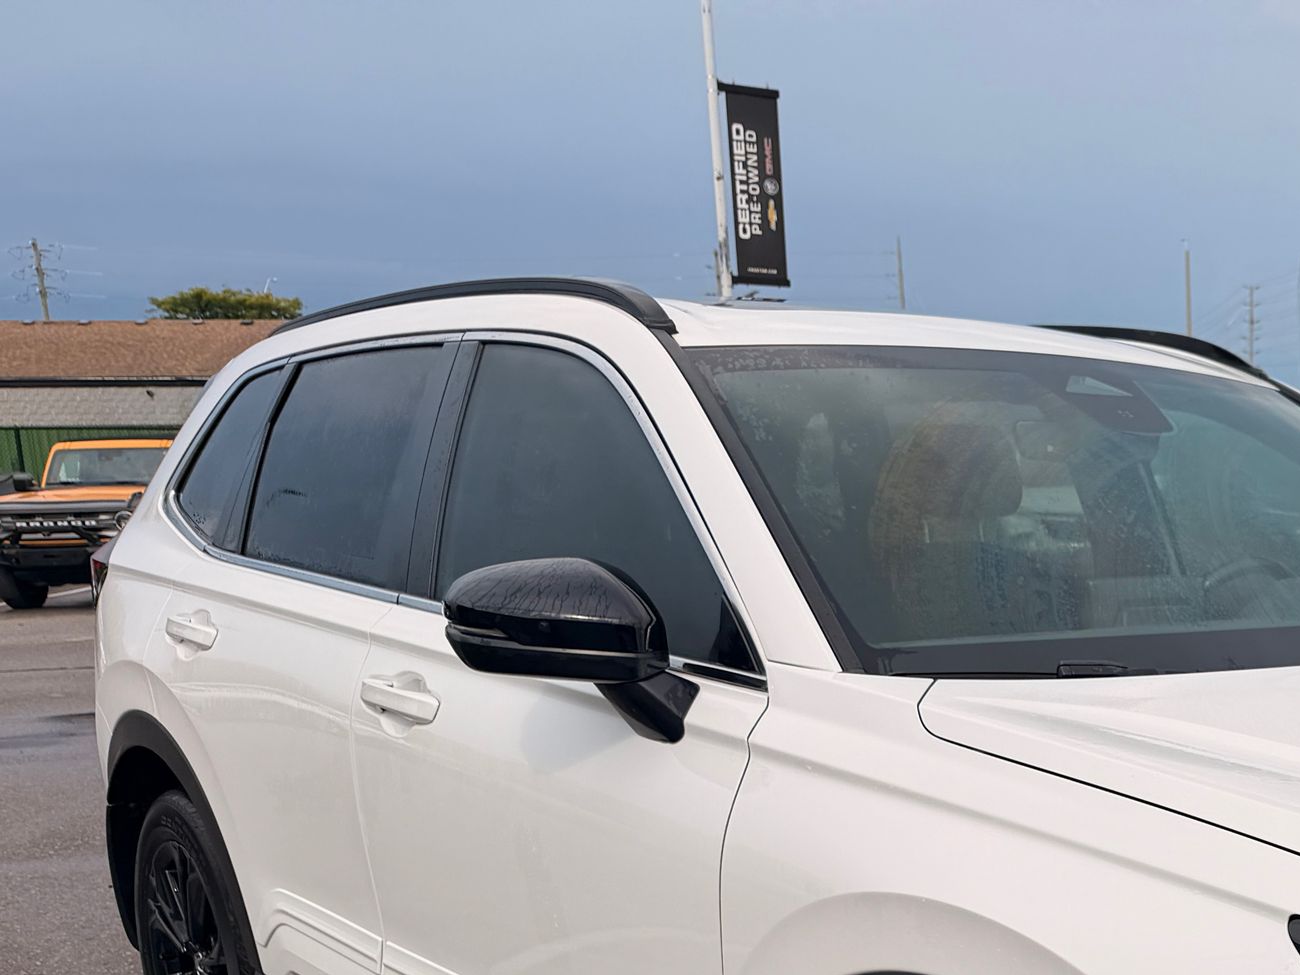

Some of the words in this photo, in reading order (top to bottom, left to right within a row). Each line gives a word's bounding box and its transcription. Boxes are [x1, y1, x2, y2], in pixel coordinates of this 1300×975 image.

[731, 122, 751, 240] CERTIFIED
[744, 129, 763, 236] PRE-OWNED
[763, 136, 774, 176] GMC
